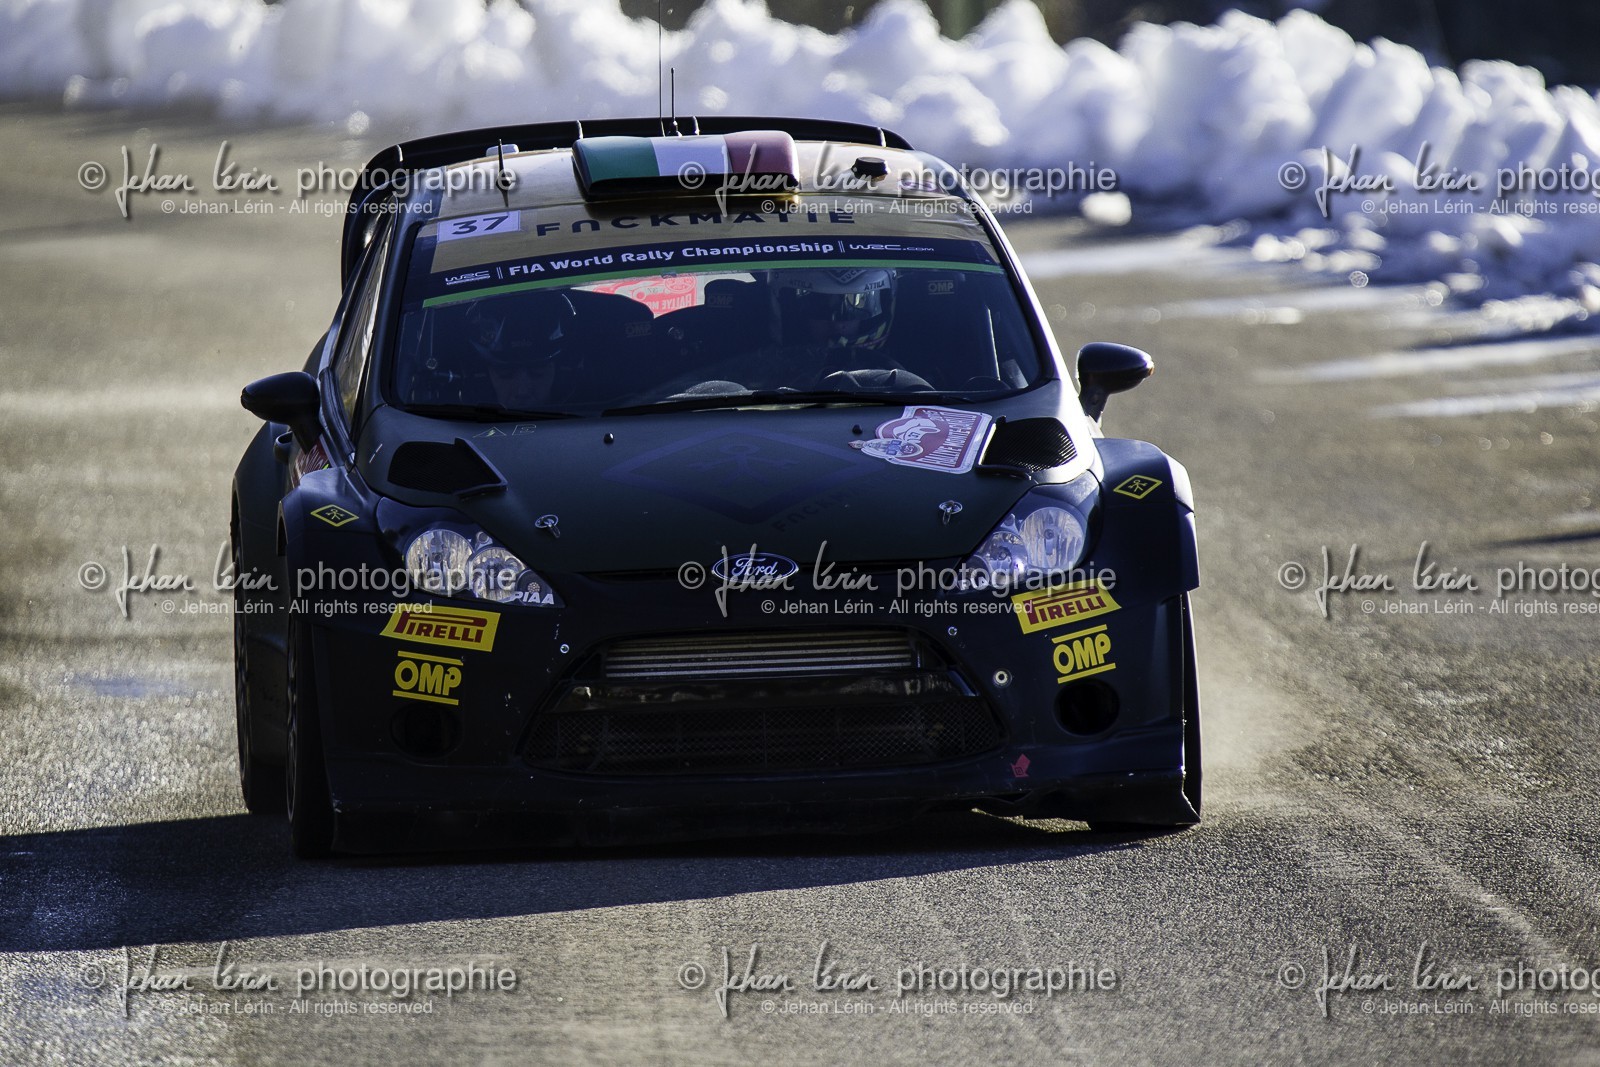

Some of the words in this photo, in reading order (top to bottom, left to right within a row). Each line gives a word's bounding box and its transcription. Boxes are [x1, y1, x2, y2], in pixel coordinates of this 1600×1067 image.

[451, 215, 510, 235] 37
[509, 263, 545, 276] FIA
[549, 254, 613, 271] World
[621, 249, 675, 263] Rally
[682, 242, 834, 258] Championship
[864, 280, 885, 291] ATTILA
[928, 281, 954, 293] OMP
[731, 557, 779, 576] Ford
[512, 590, 555, 605] PIAA
[1022, 585, 1107, 626] PIRELLI
[393, 611, 488, 643] PIRELLI
[1053, 633, 1112, 675] OMP
[394, 659, 462, 697] OMP
